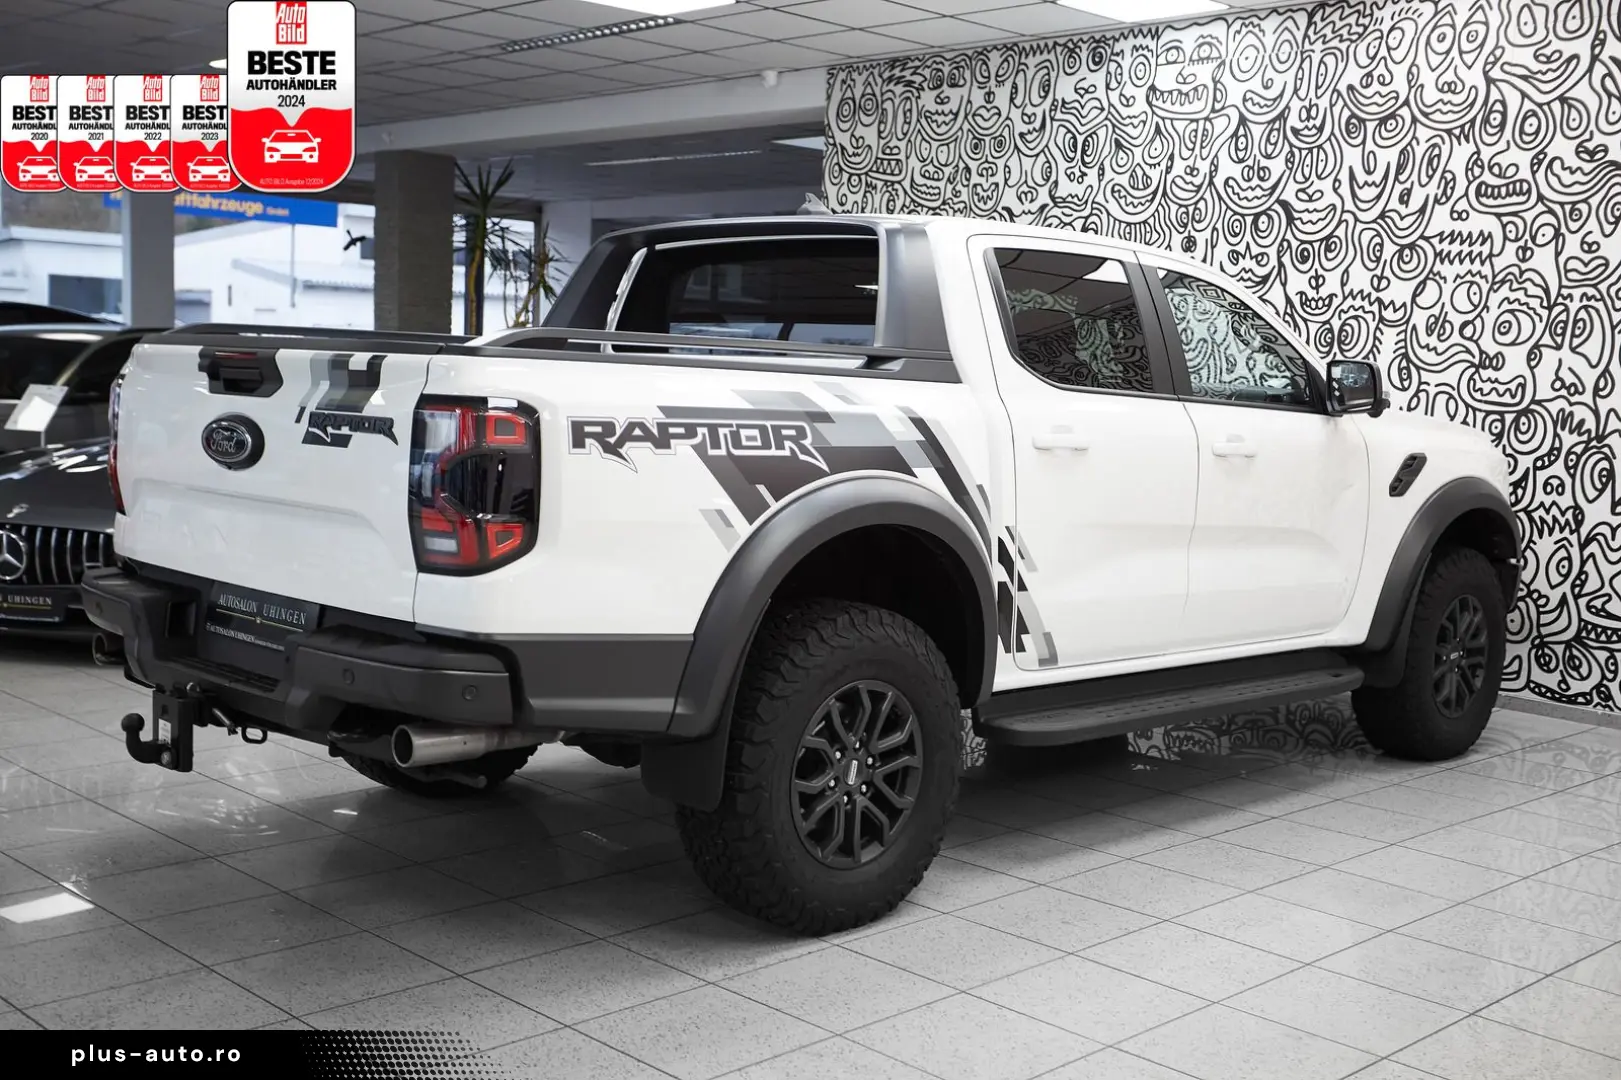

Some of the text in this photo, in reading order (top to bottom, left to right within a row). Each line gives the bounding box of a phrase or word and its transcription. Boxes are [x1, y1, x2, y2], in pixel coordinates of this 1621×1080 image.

[210, 428, 238, 453] Ford
[308, 411, 398, 446] RAPTOR
[567, 416, 830, 473] RAPTOR
[218, 593, 307, 625] AUTOSALON UHINGEN
